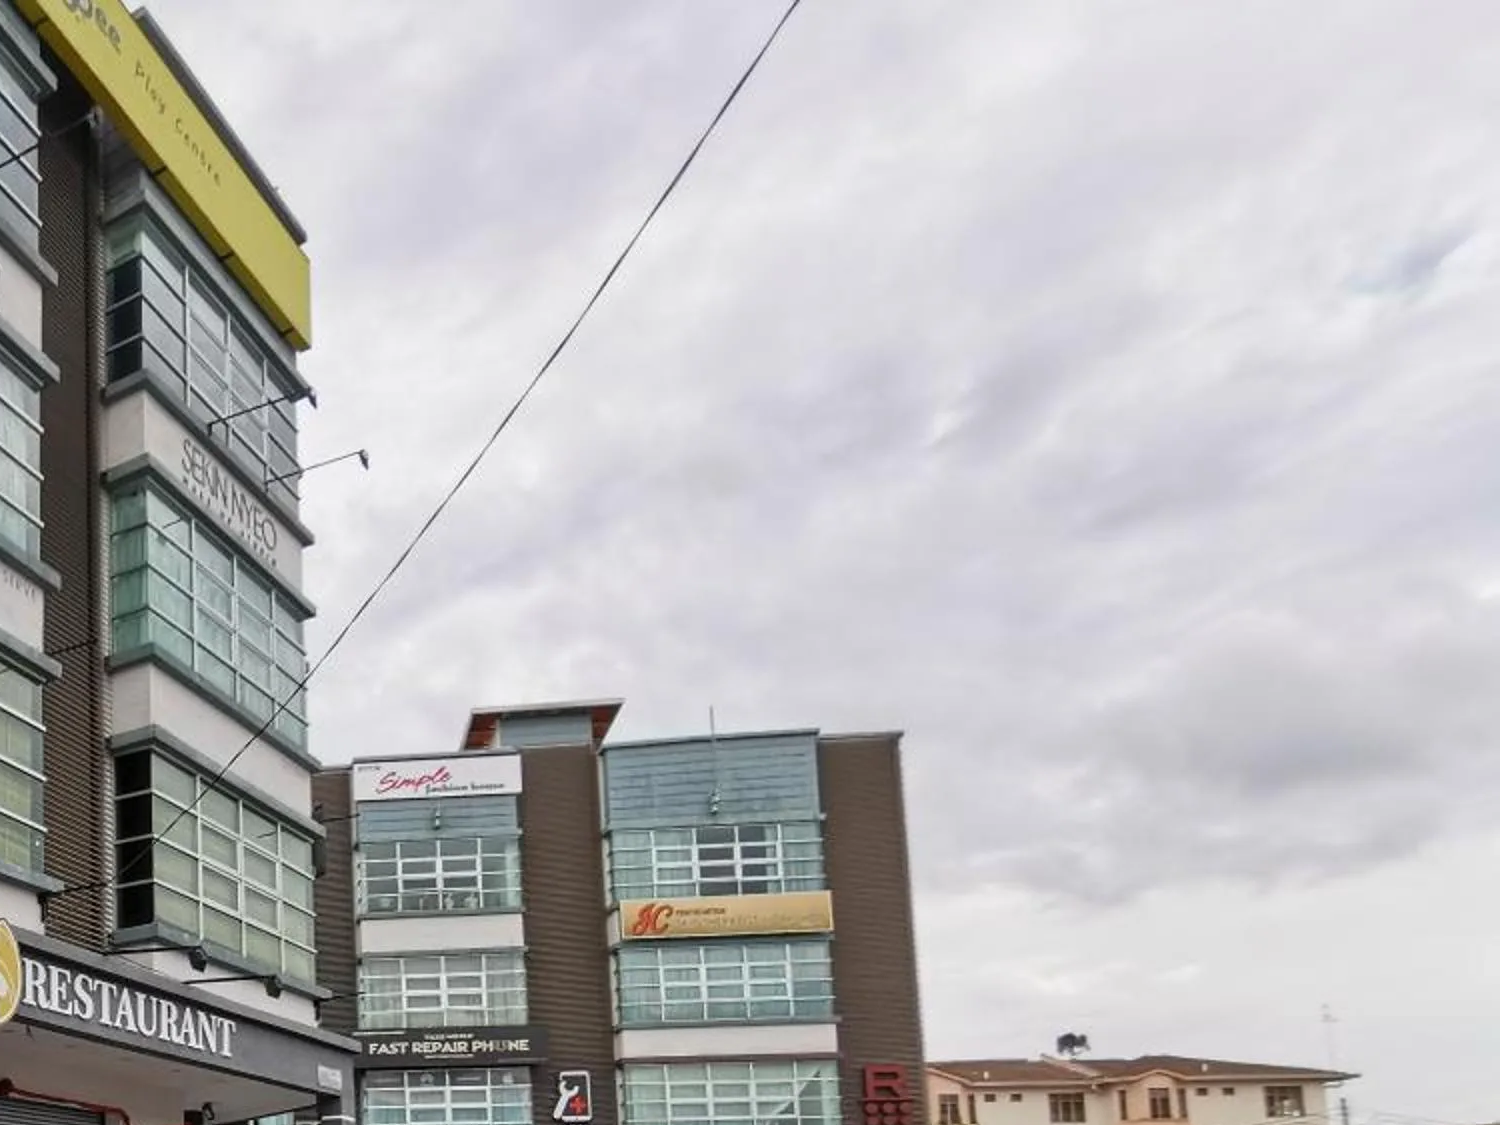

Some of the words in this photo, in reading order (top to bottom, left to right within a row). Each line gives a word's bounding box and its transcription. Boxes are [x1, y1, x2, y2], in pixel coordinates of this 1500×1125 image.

[374, 765, 453, 795] Simple
[23, 957, 238, 1059] RESTAURANT
[368, 1042, 410, 1055] FAST
[411, 1040, 468, 1053] REPAIR
